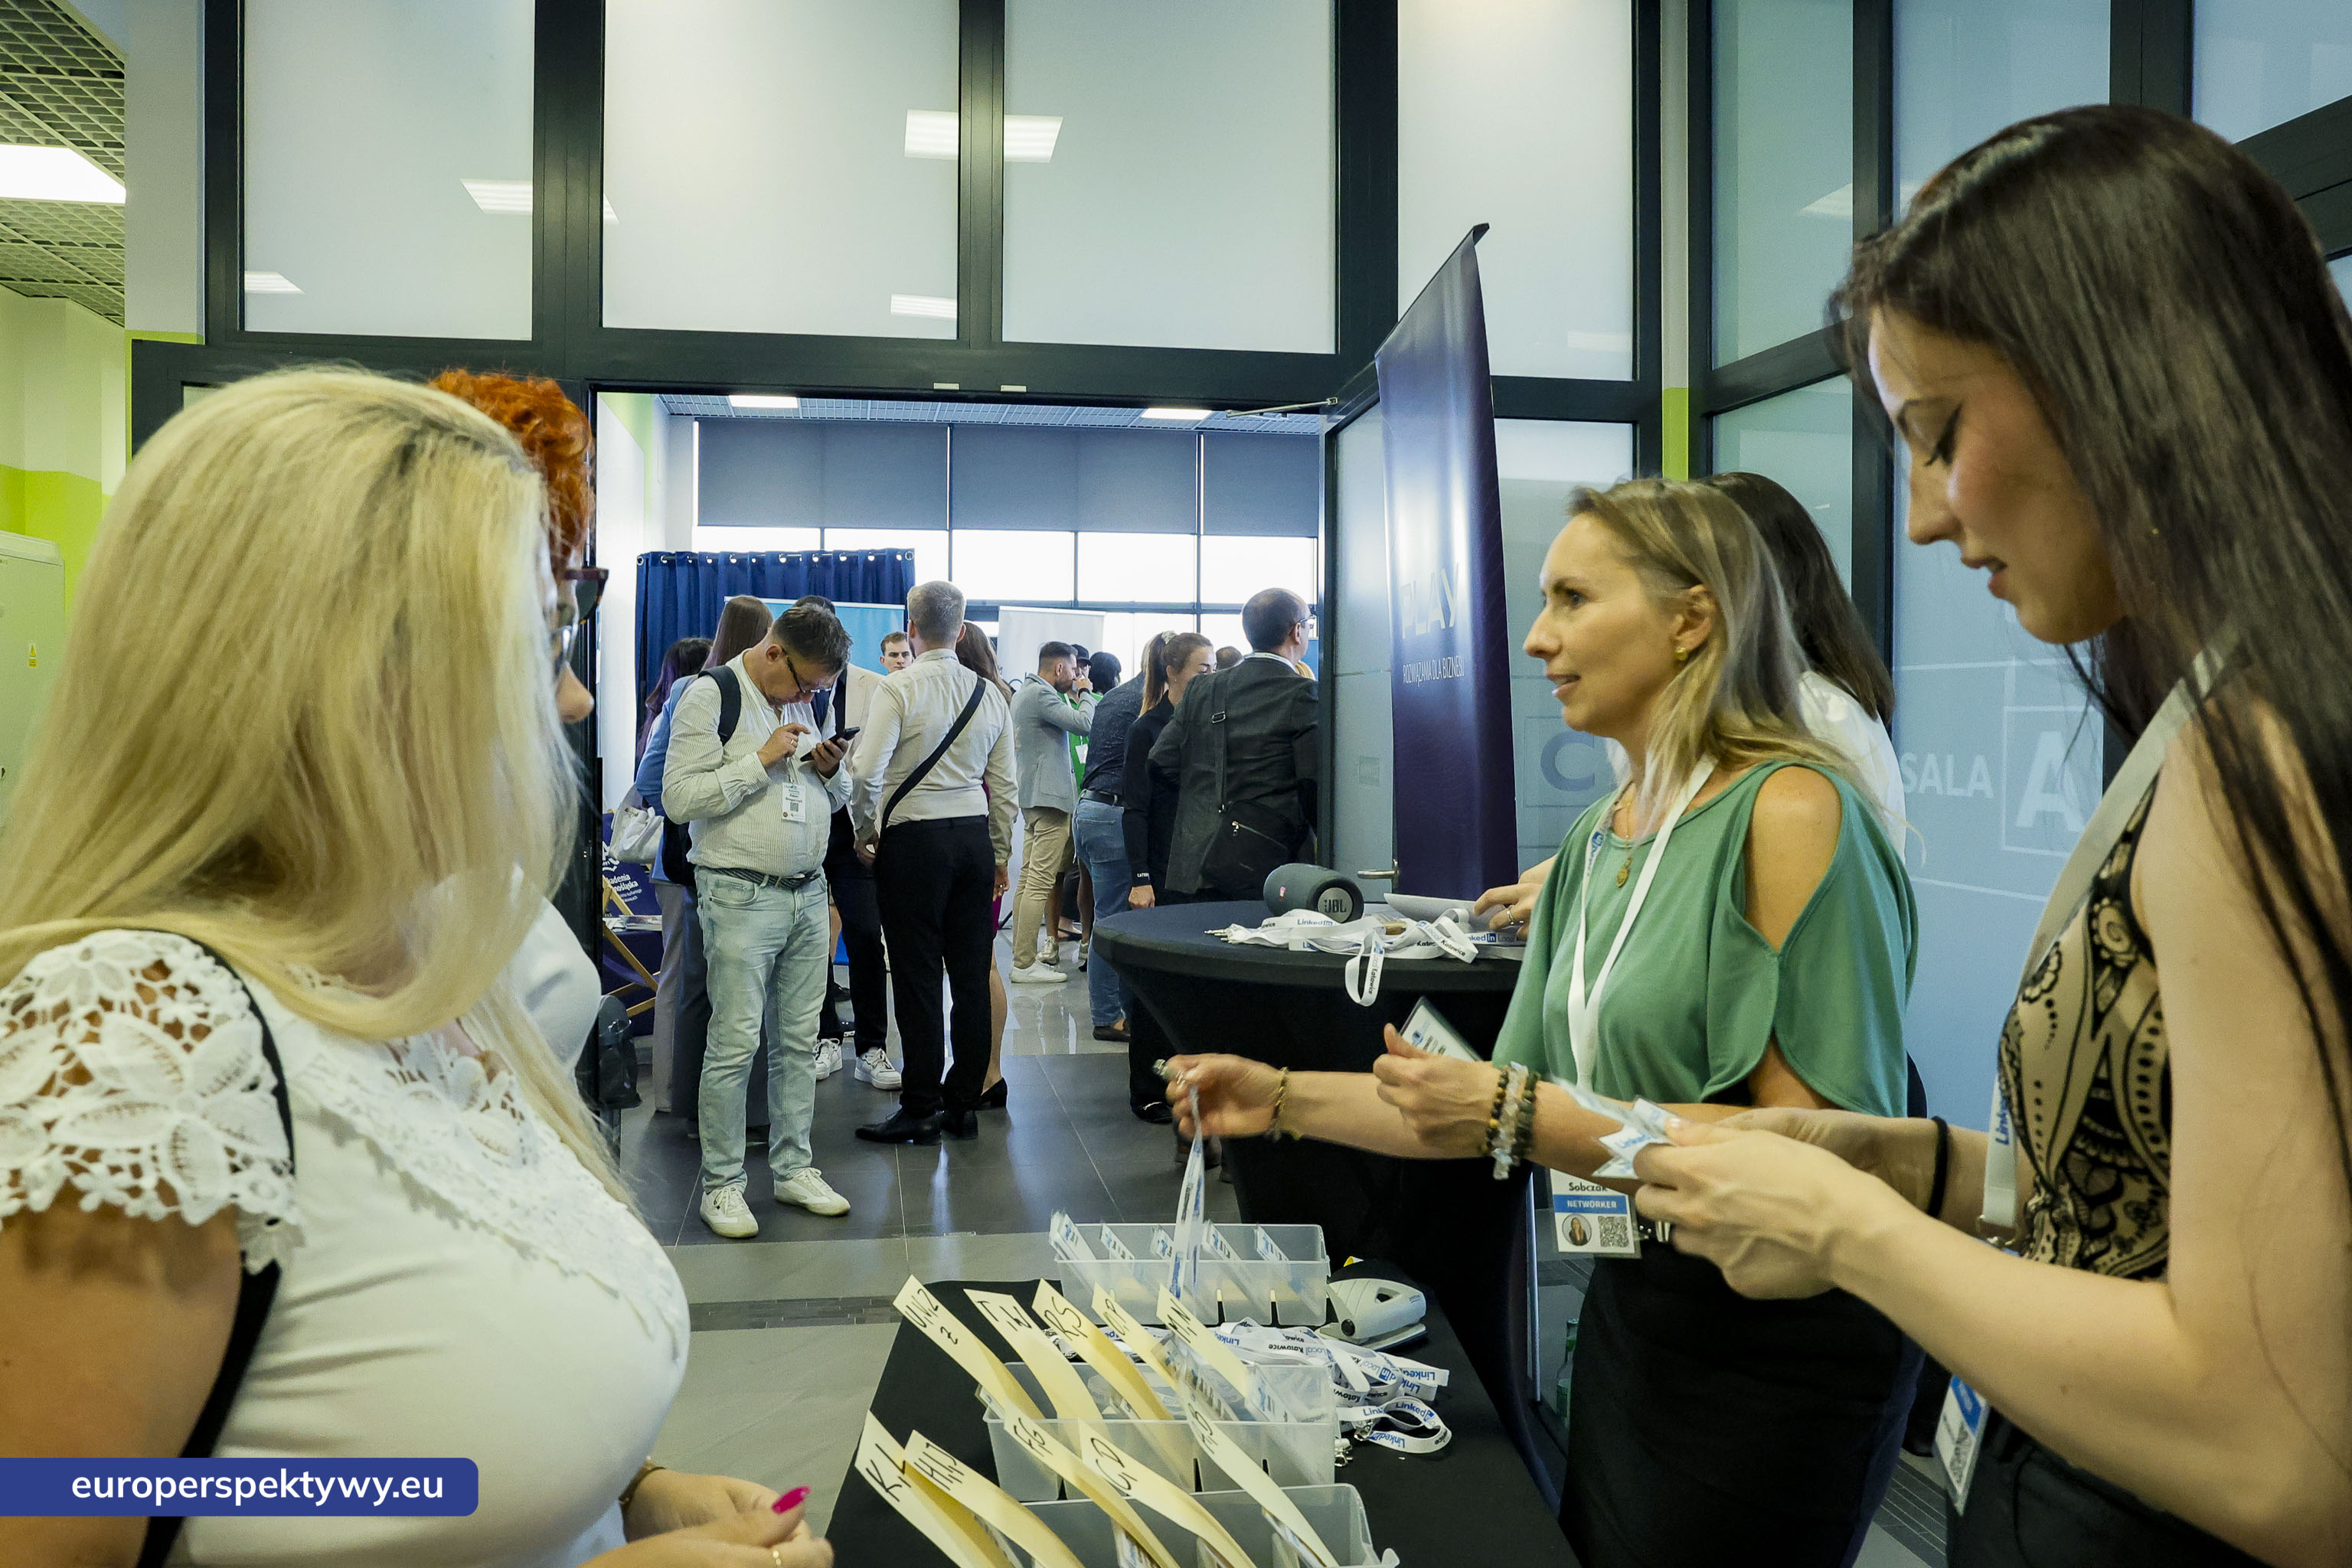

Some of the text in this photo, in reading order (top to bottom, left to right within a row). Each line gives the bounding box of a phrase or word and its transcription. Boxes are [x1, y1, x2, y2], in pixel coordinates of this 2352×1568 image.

[1901, 730, 2088, 833] SALA A
[1324, 899, 1348, 913] JBL
[1440, 939, 1466, 958] Katowice
[1566, 1199, 1618, 1209] NETWORKER
